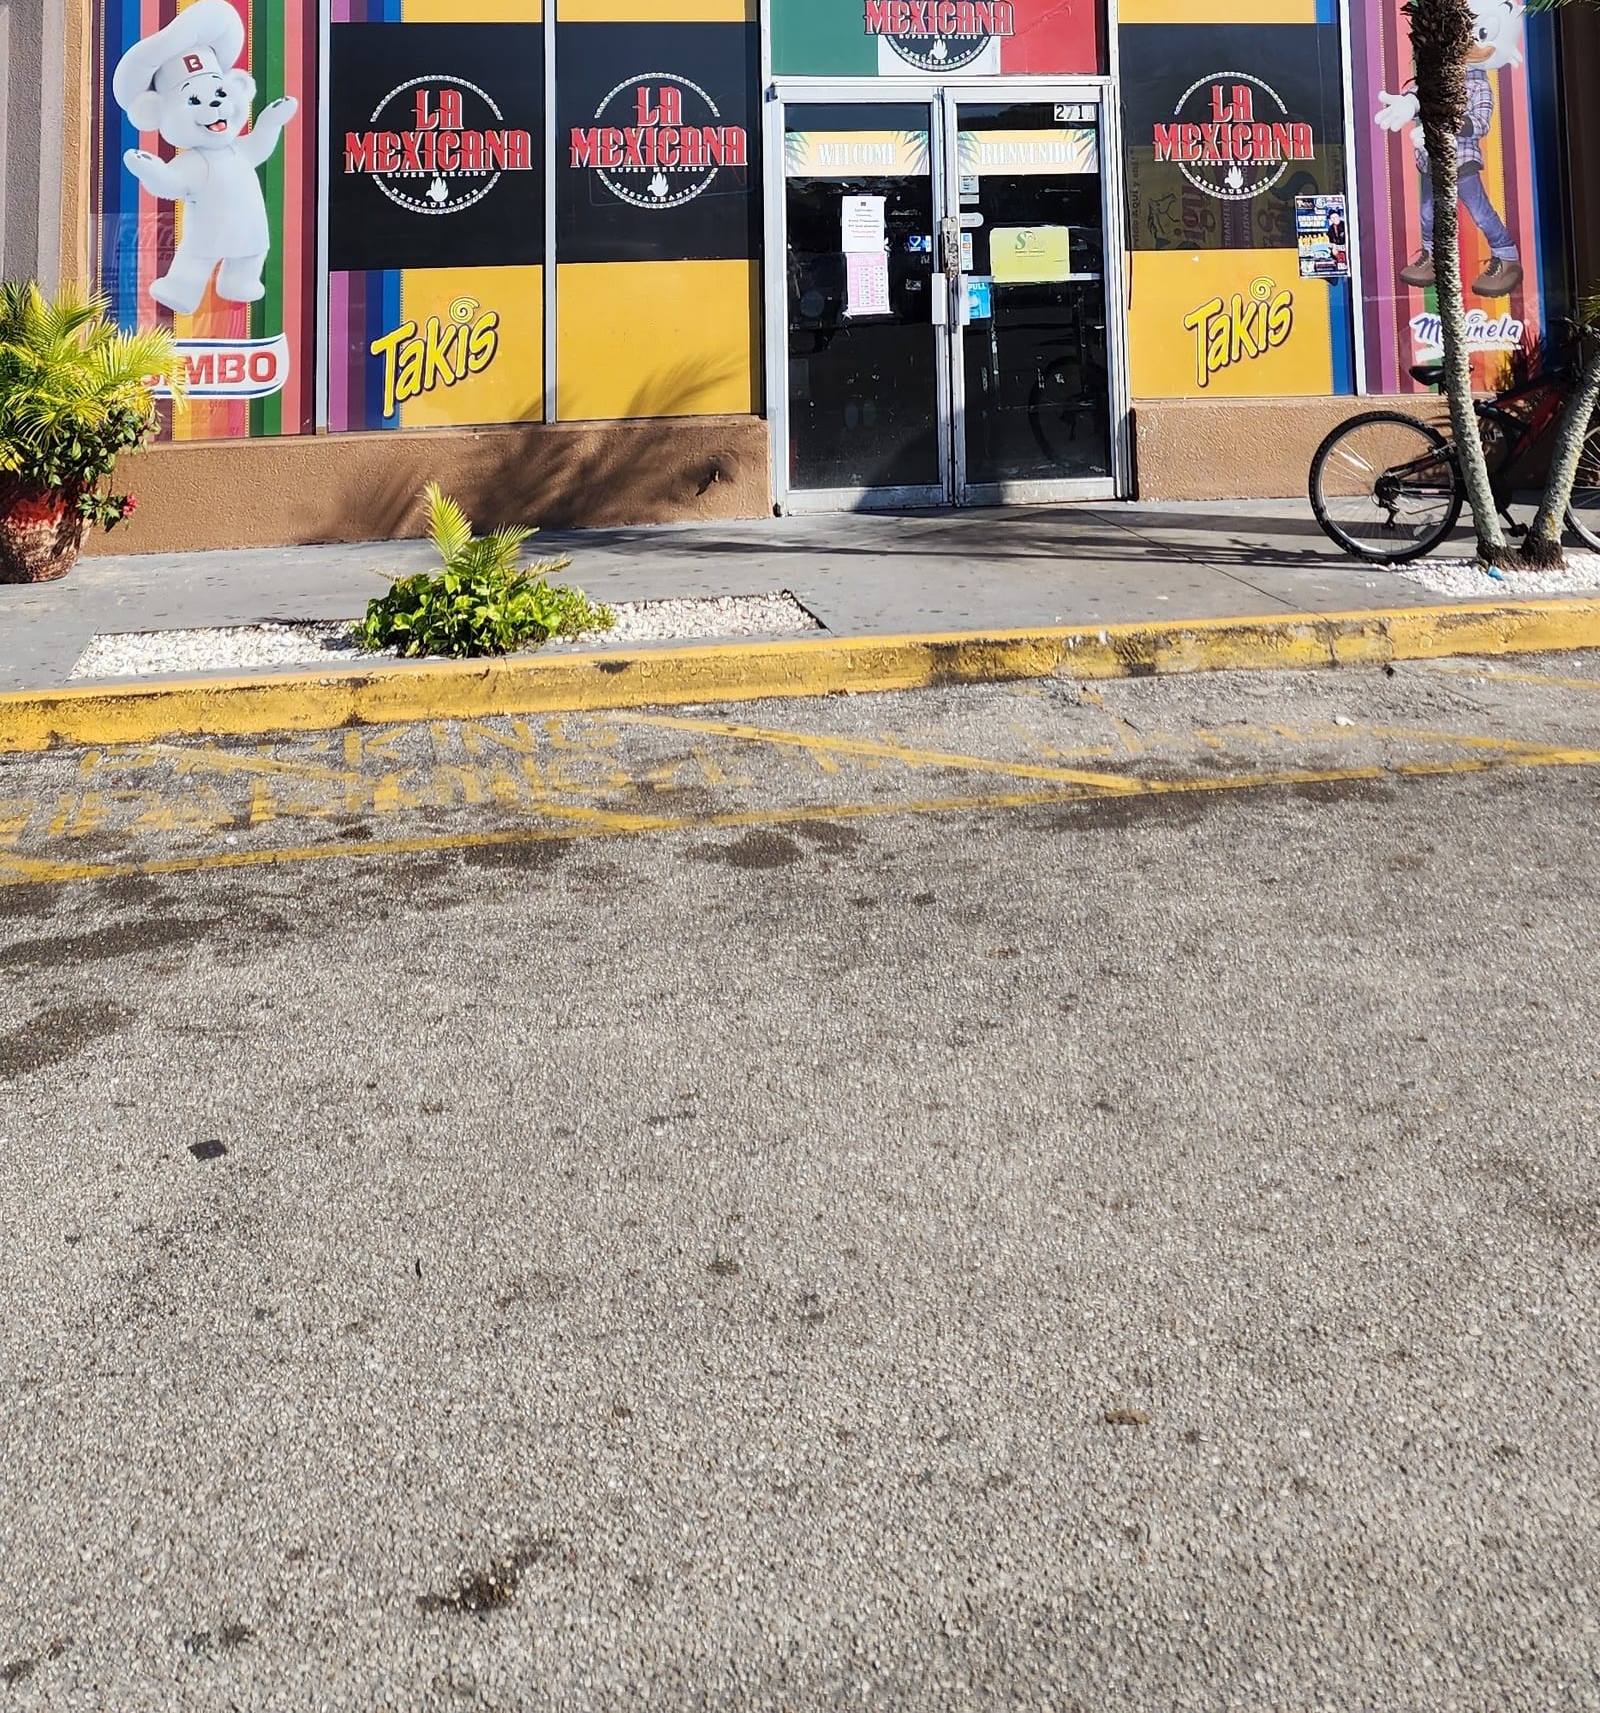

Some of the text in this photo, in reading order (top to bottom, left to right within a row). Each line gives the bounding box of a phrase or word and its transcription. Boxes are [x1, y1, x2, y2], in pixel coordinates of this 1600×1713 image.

[183, 54, 203, 73] B
[902, 46, 972, 65] RESTAURANTE
[411, 89, 464, 130] LA
[632, 86, 683, 126] LA
[1208, 84, 1254, 123] LA
[342, 128, 533, 173] MEXICANA
[568, 125, 748, 168] MEXICANA
[818, 142, 897, 166] WELCOME
[979, 142, 1077, 166] BIENVENIDO
[1152, 121, 1316, 161] MEXICANA
[392, 187, 479, 208] RESTAURANTE
[614, 182, 697, 203] RESTAURANTE
[1195, 175, 1270, 194] RESTAURANTE
[1183, 276, 1293, 388] Takis
[370, 297, 500, 418] Takis
